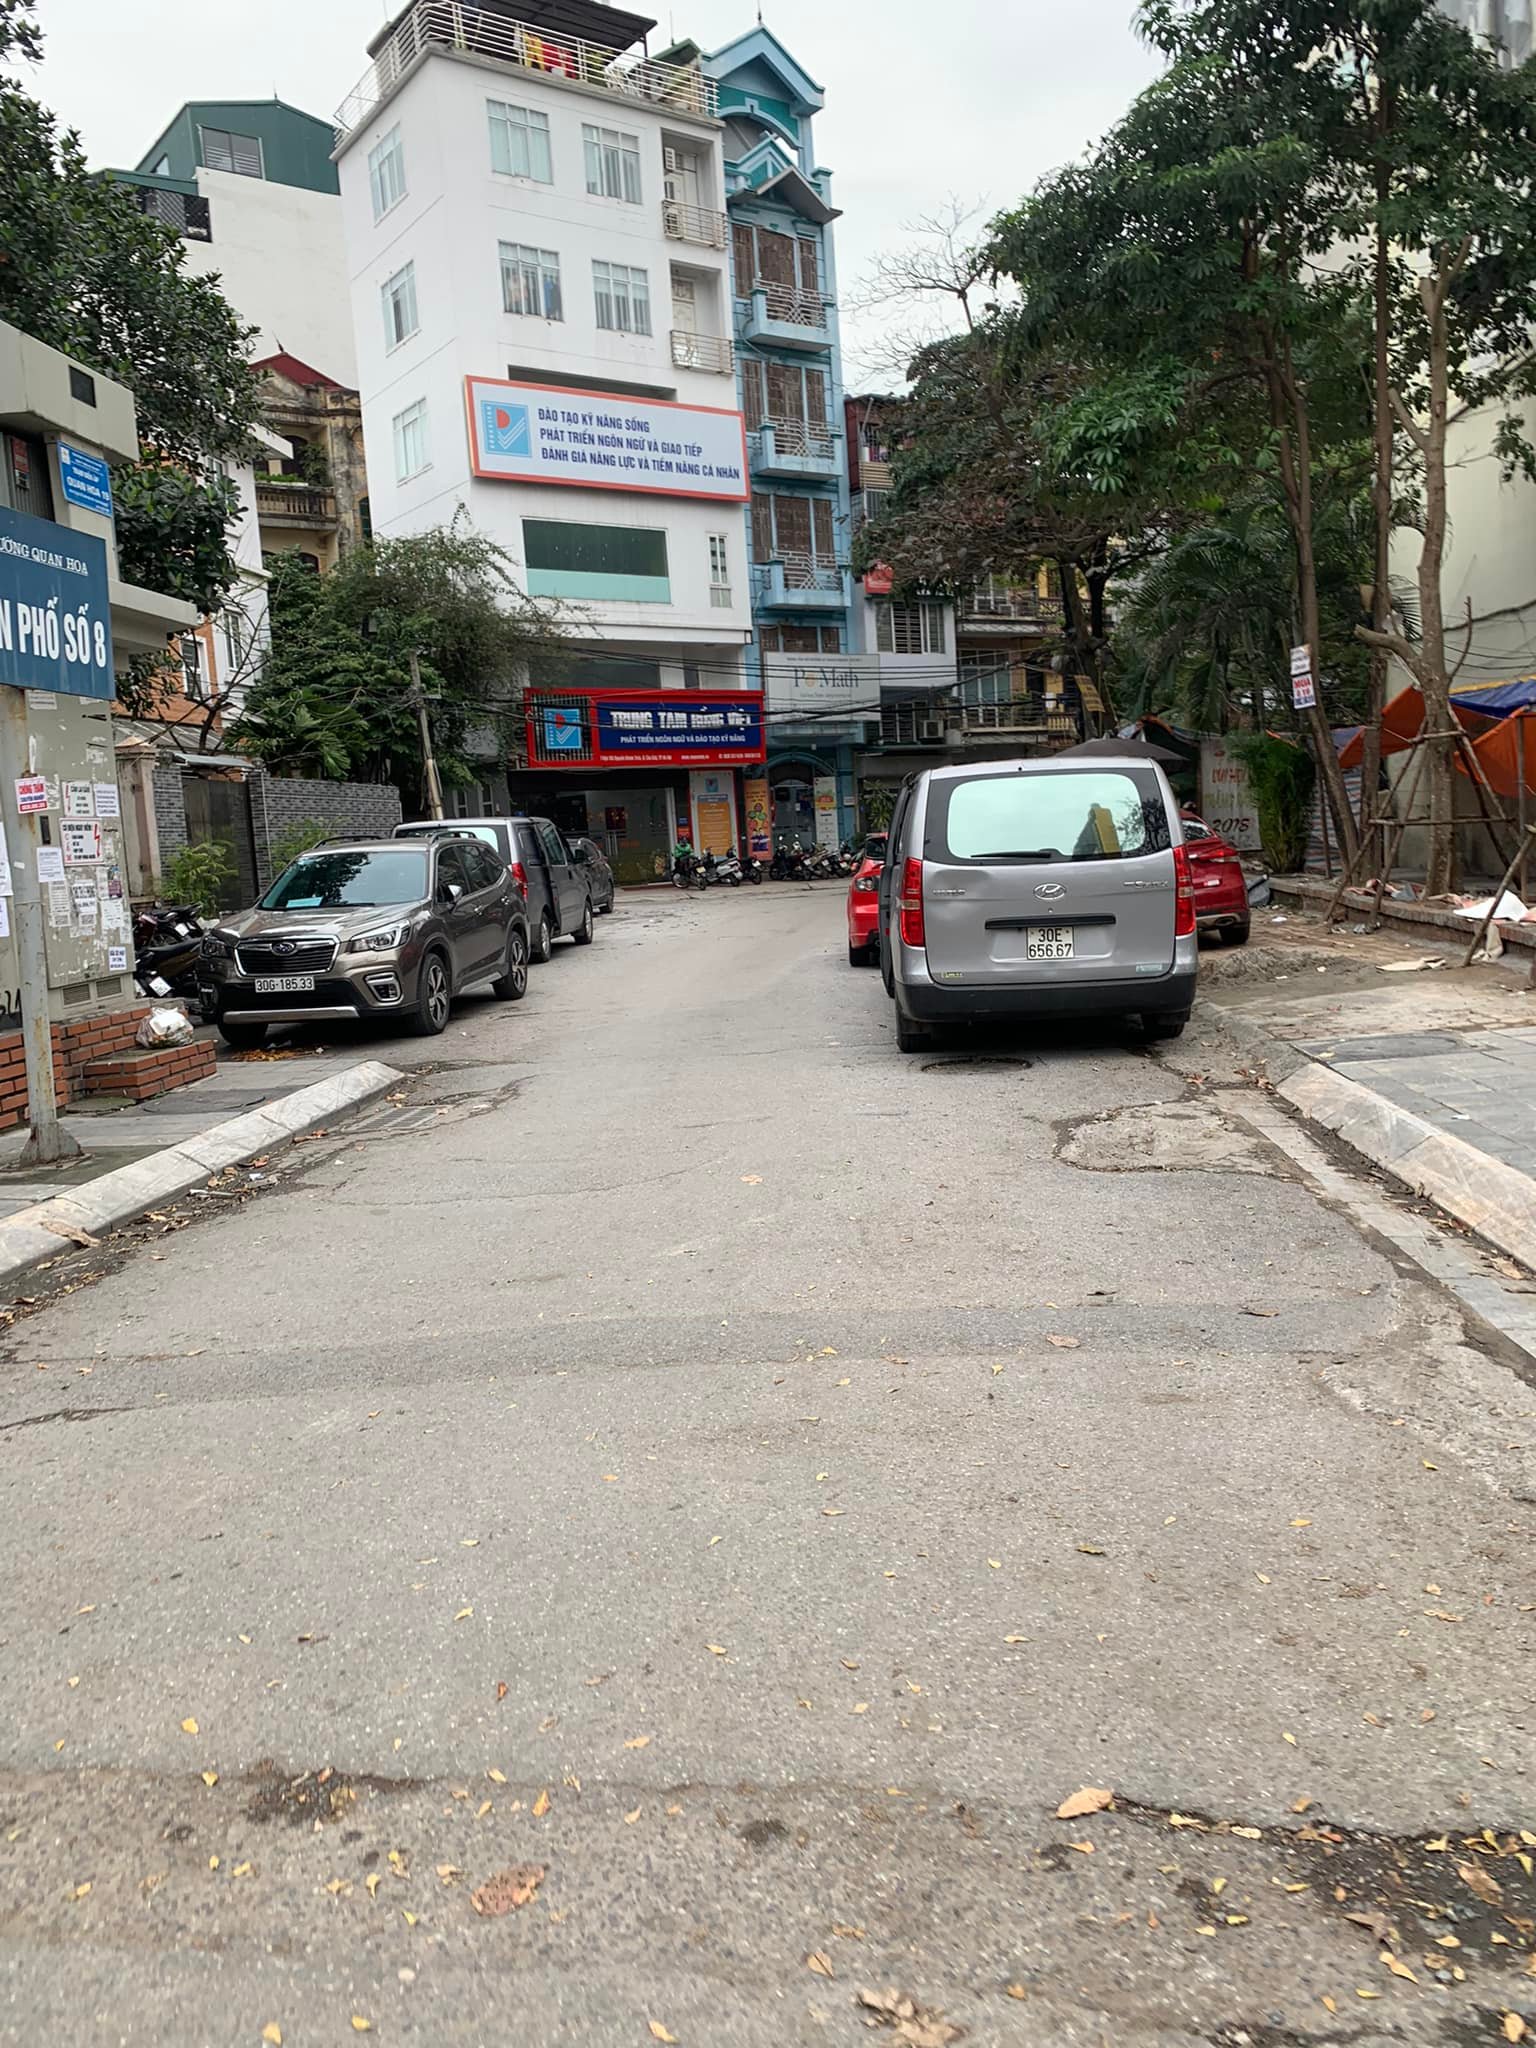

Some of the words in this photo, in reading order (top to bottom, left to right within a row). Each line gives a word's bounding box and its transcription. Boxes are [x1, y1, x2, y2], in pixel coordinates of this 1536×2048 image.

[538, 407, 558, 422] ĐÀO
[560, 411, 578, 426] TẠO
[624, 416, 650, 432] SỐNG
[540, 427, 565, 442] PHÁT
[598, 433, 624, 448] NGÔN
[661, 442, 681, 455] GIAO
[684, 441, 702, 457] TIẾP
[619, 455, 635, 470] LỰC
[702, 464, 714, 477] CÁ
[32, 548, 63, 567] QUAN
[66, 558, 88, 574] HOA
[17, 596, 60, 660] PHỐ
[64, 603, 90, 665] SỐ
[94, 621, 106, 668] 8
[610, 711, 653, 729] TRUNG
[620, 734, 636, 743] PHÁT
[708, 735, 720, 744] TẠO
[1038, 929, 1062, 942] 30E
[1029, 944, 1072, 958] 656.67
